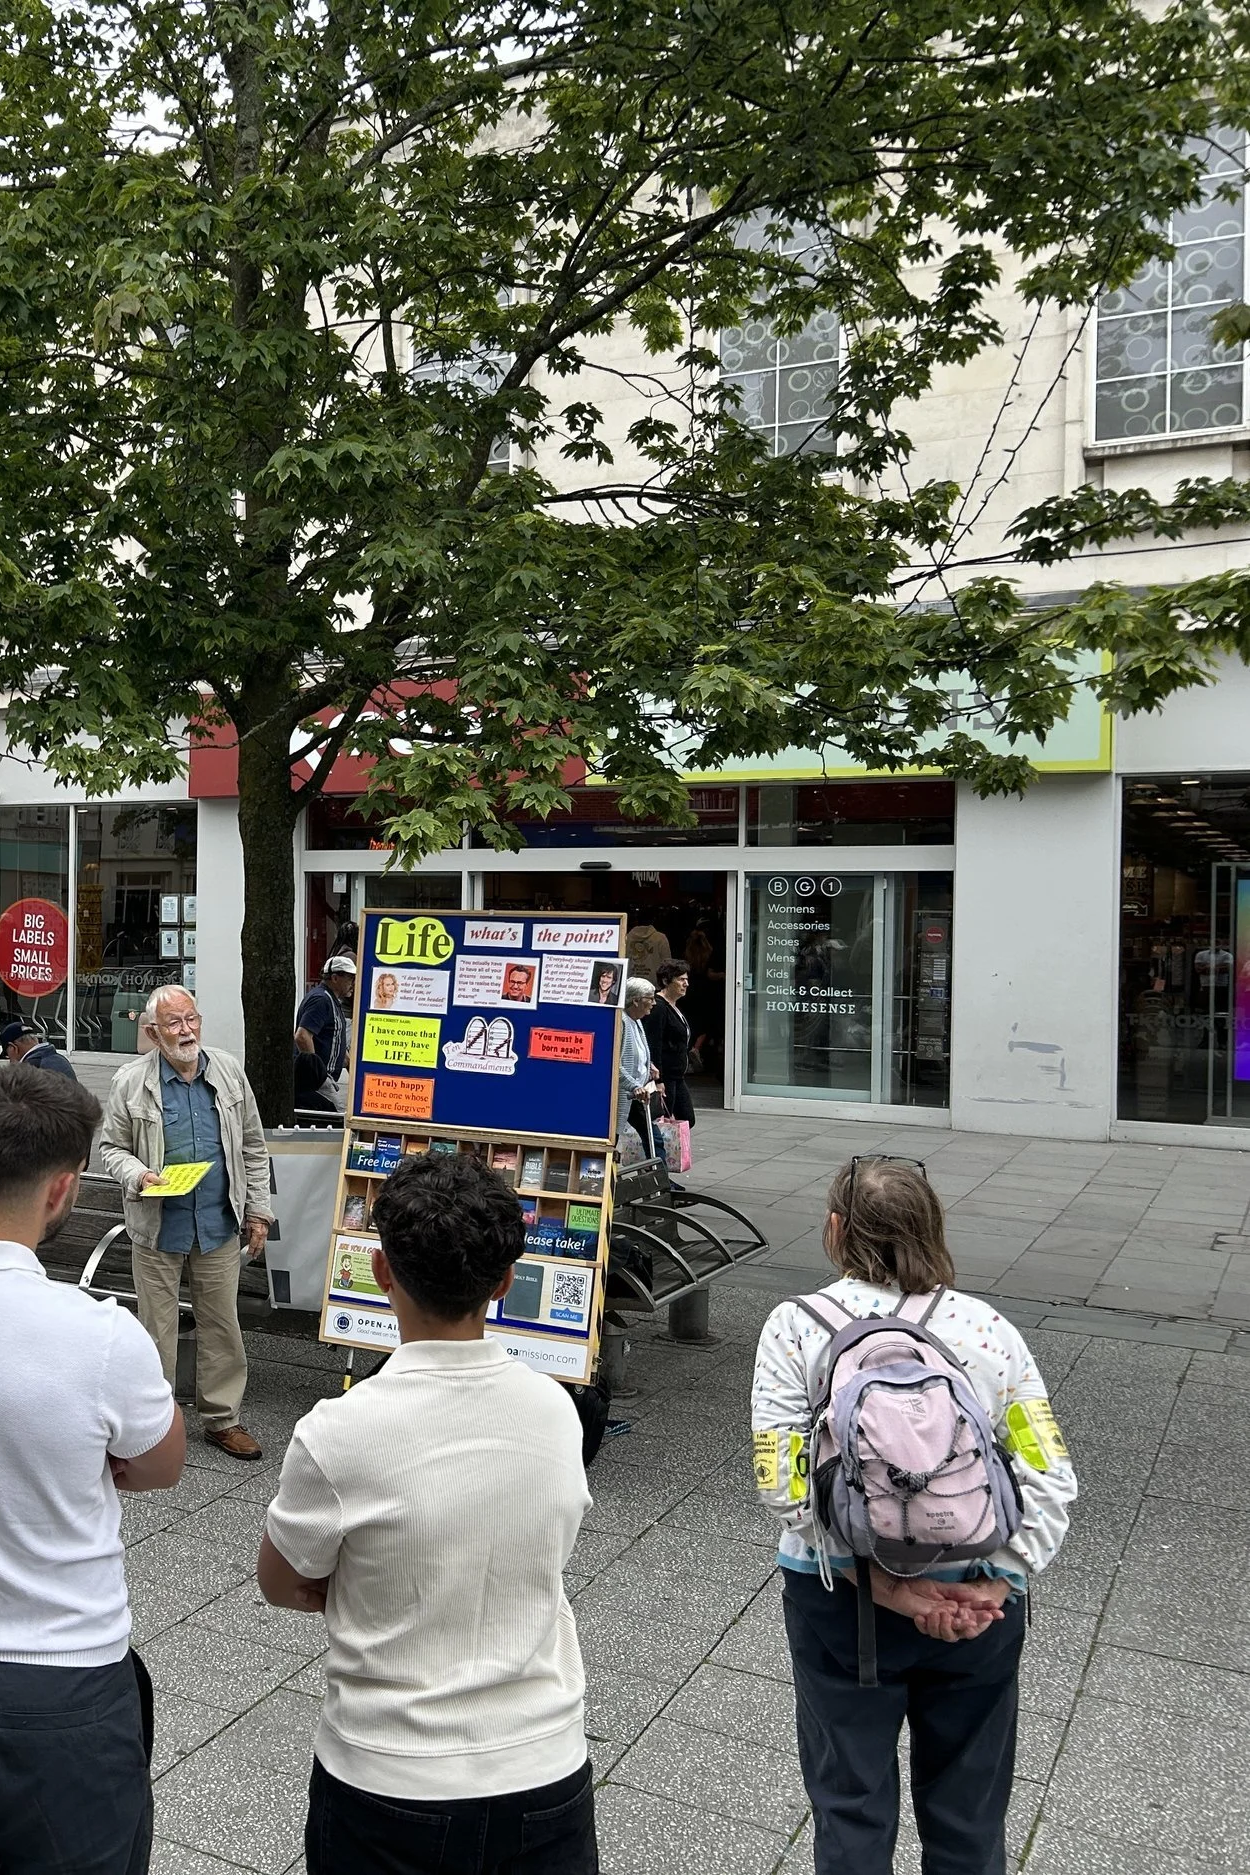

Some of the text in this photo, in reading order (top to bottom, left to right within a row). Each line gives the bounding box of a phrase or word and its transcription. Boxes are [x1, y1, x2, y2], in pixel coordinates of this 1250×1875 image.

[767, 903, 815, 914] Womens
[24, 913, 45, 929] BIG
[767, 920, 831, 931] Accessories
[12, 928, 55, 946] LABELS
[375, 922, 614, 959] Life what's the point?
[767, 936, 800, 946] Shoes
[13, 947, 51, 966] SMALL
[766, 952, 796, 963] Mens
[10, 963, 53, 981] PRICES
[766, 968, 790, 979] Kids
[766, 984, 853, 998] Click & Collect
[765, 1001, 856, 1015] HOMESENSE
[376, 1026, 437, 1039] have come that
[374, 1038, 430, 1050] you may have
[553, 1034, 573, 1044] must
[574, 1036, 583, 1044] be
[445, 1043, 461, 1055] Ten
[541, 1043, 558, 1053] born
[447, 1058, 513, 1073] Commandments
[400, 1080, 426, 1092] happy
[367, 1088, 429, 1102] is the one whose
[364, 1100, 379, 1108] sins
[357, 1155, 402, 1169] Free leaf
[524, 1161, 543, 1171] BIBLE
[576, 1208, 600, 1217] ULTIMATE
[571, 1215, 599, 1224] QUESTIONS
[524, 1233, 586, 1251] lease take!
[555, 1311, 569, 1319] SCAN
[357, 1318, 399, 1331] OPEN-AI
[506, 1347, 578, 1365] oamission.com
